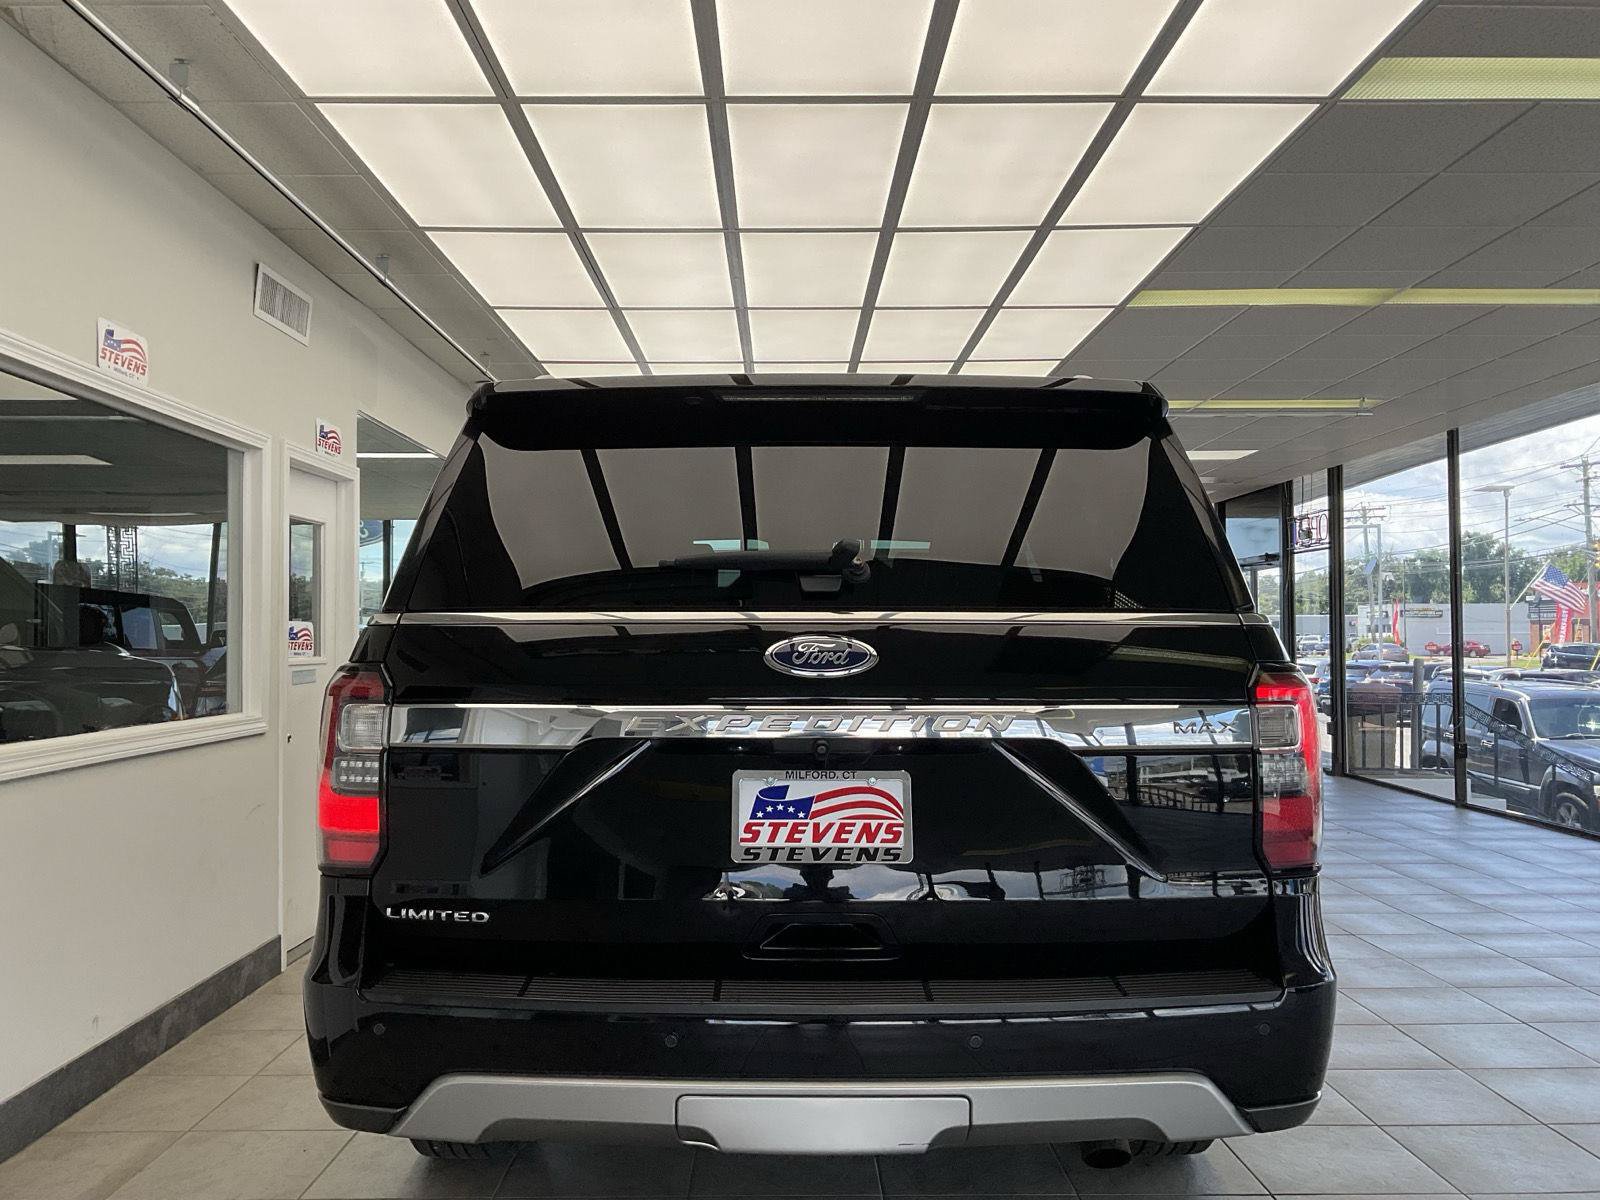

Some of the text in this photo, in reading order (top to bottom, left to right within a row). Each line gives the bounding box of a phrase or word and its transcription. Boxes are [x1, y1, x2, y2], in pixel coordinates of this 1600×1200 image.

[100, 347, 147, 376] STEVENS
[318, 438, 341, 454] STEVENS
[792, 642, 851, 665] Ford
[627, 713, 1016, 733] EXPEDITION
[1173, 721, 1239, 734] MAX
[842, 770, 857, 779] CT
[739, 822, 904, 844] STEVENS
[741, 847, 902, 861] STEVENS
[386, 907, 490, 923] LIMITED
